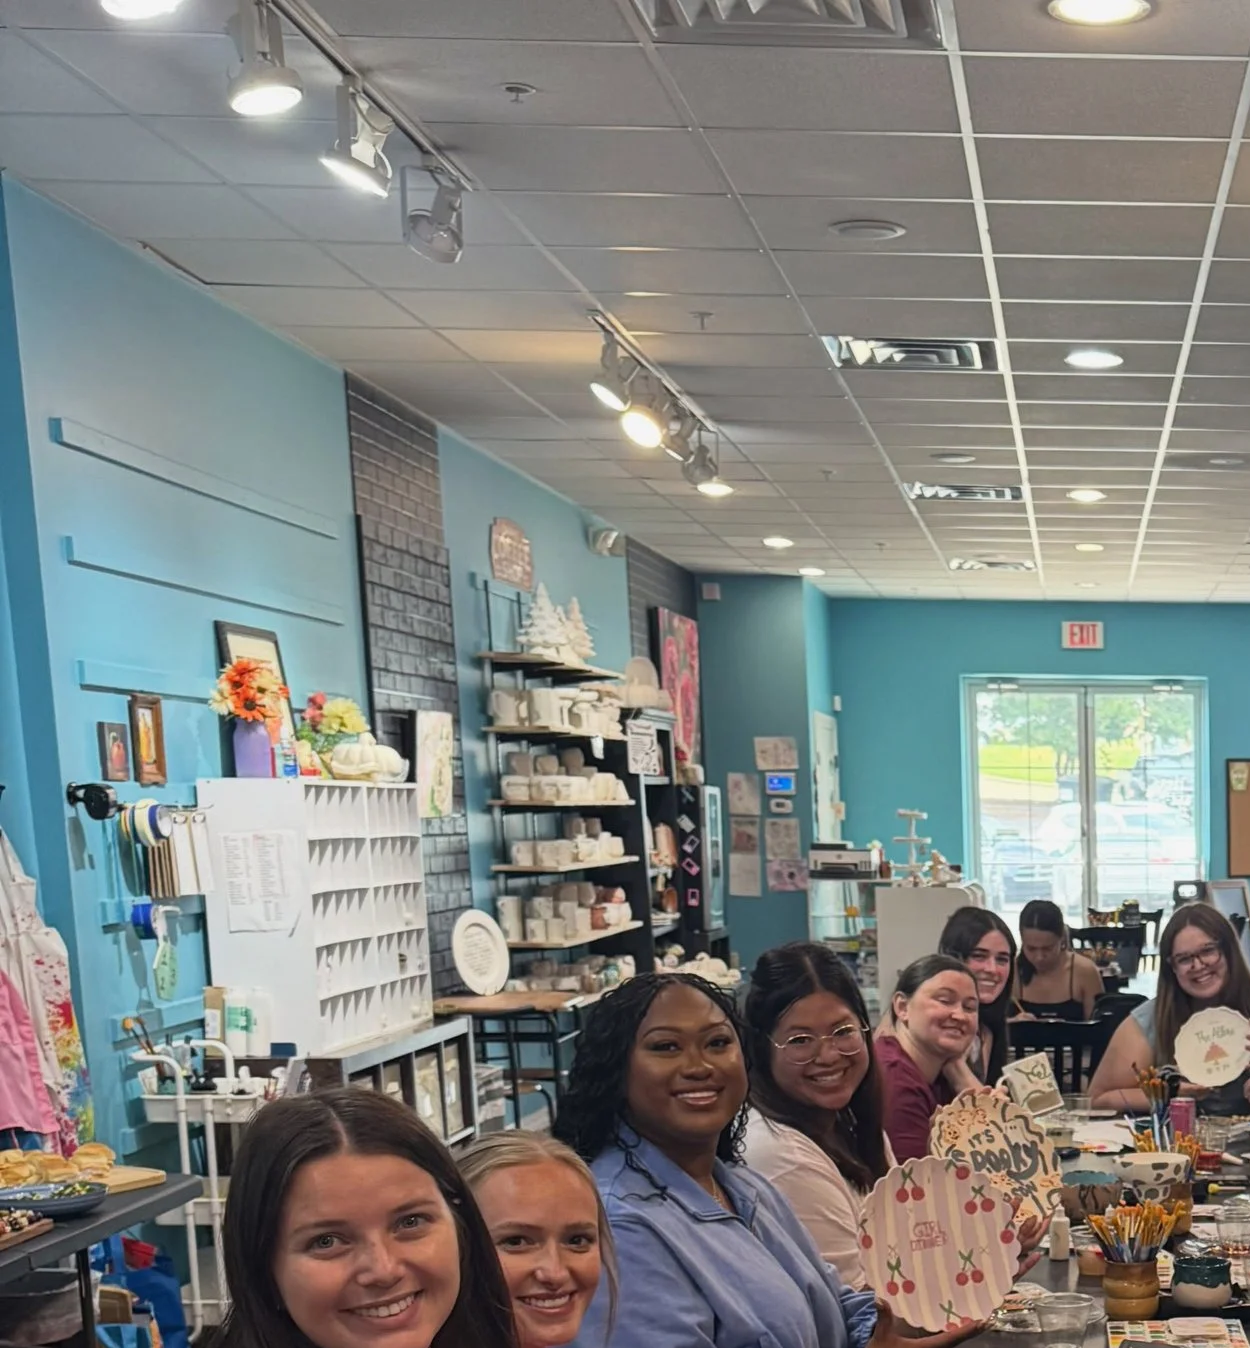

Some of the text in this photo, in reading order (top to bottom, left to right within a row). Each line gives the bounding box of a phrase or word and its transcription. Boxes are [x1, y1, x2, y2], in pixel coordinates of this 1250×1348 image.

[1069, 623, 1098, 647] EXIT
[968, 1129, 995, 1149] IT'S
[913, 1219, 943, 1238] GIRL
